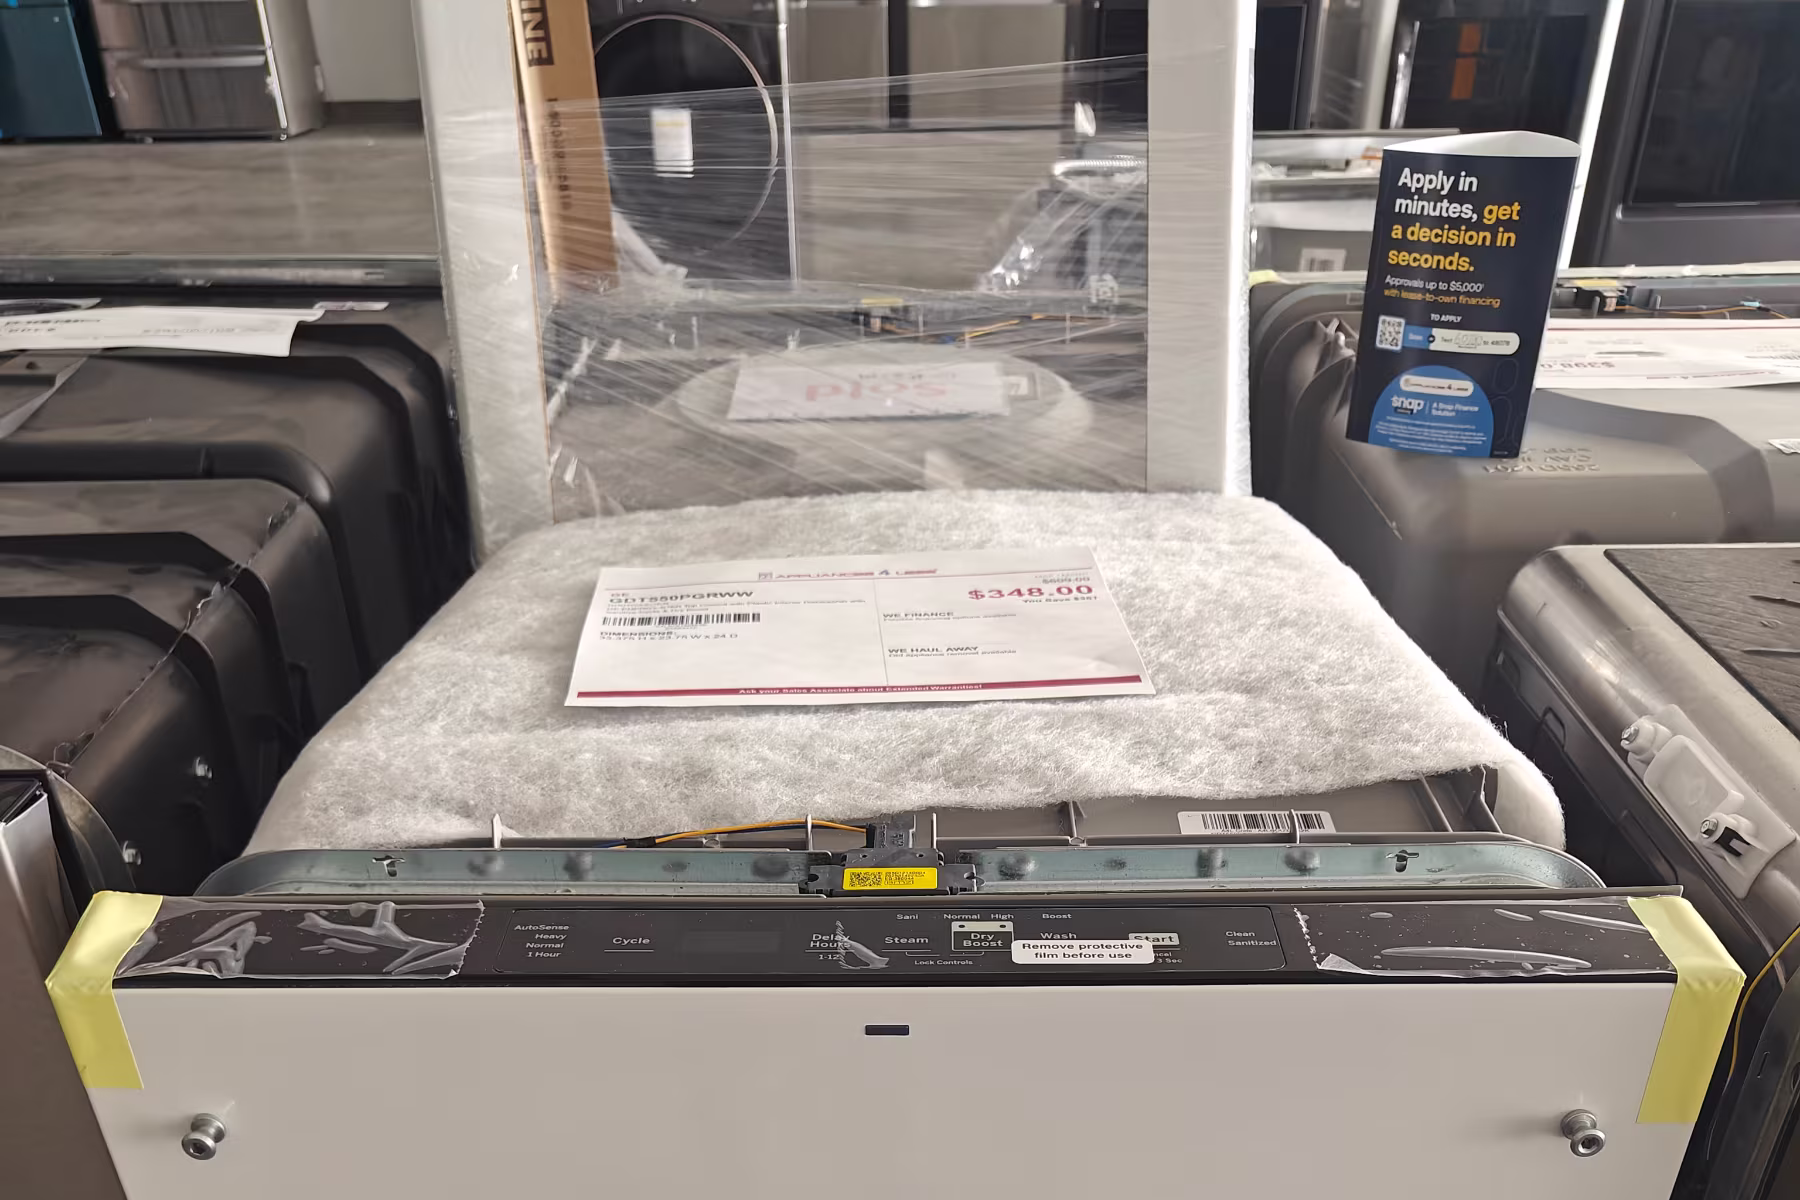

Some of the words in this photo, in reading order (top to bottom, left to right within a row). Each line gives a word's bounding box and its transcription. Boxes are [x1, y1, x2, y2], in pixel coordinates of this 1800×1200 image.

[1397, 167, 1455, 195] Apply
[1458, 171, 1478, 192] in
[1395, 195, 1478, 222] minutes,
[1482, 202, 1521, 225] get
[1391, 224, 1403, 239] a
[1406, 222, 1491, 247] decision
[1496, 227, 1516, 247] in
[1388, 249, 1474, 272] seconds.
[1385, 275, 1424, 288] Approvals
[1425, 282, 1437, 291] up
[1439, 281, 1448, 290] to
[1384, 288, 1400, 298] with
[1401, 290, 1457, 304] lease-to-own
[1459, 295, 1501, 309] financing
[1430, 313, 1440, 322] TO
[1441, 314, 1462, 323] APPLY
[1391, 395, 1424, 413] snap
[968, 585, 1093, 601] $348.00
[534, 933, 567, 941] Heavy
[612, 937, 650, 946] Cycle
[812, 933, 850, 942] Delay
[971, 932, 994, 941] Dry
[1040, 932, 1077, 940] Wash
[1134, 935, 1175, 943] Start
[1078, 943, 1143, 951] protective
